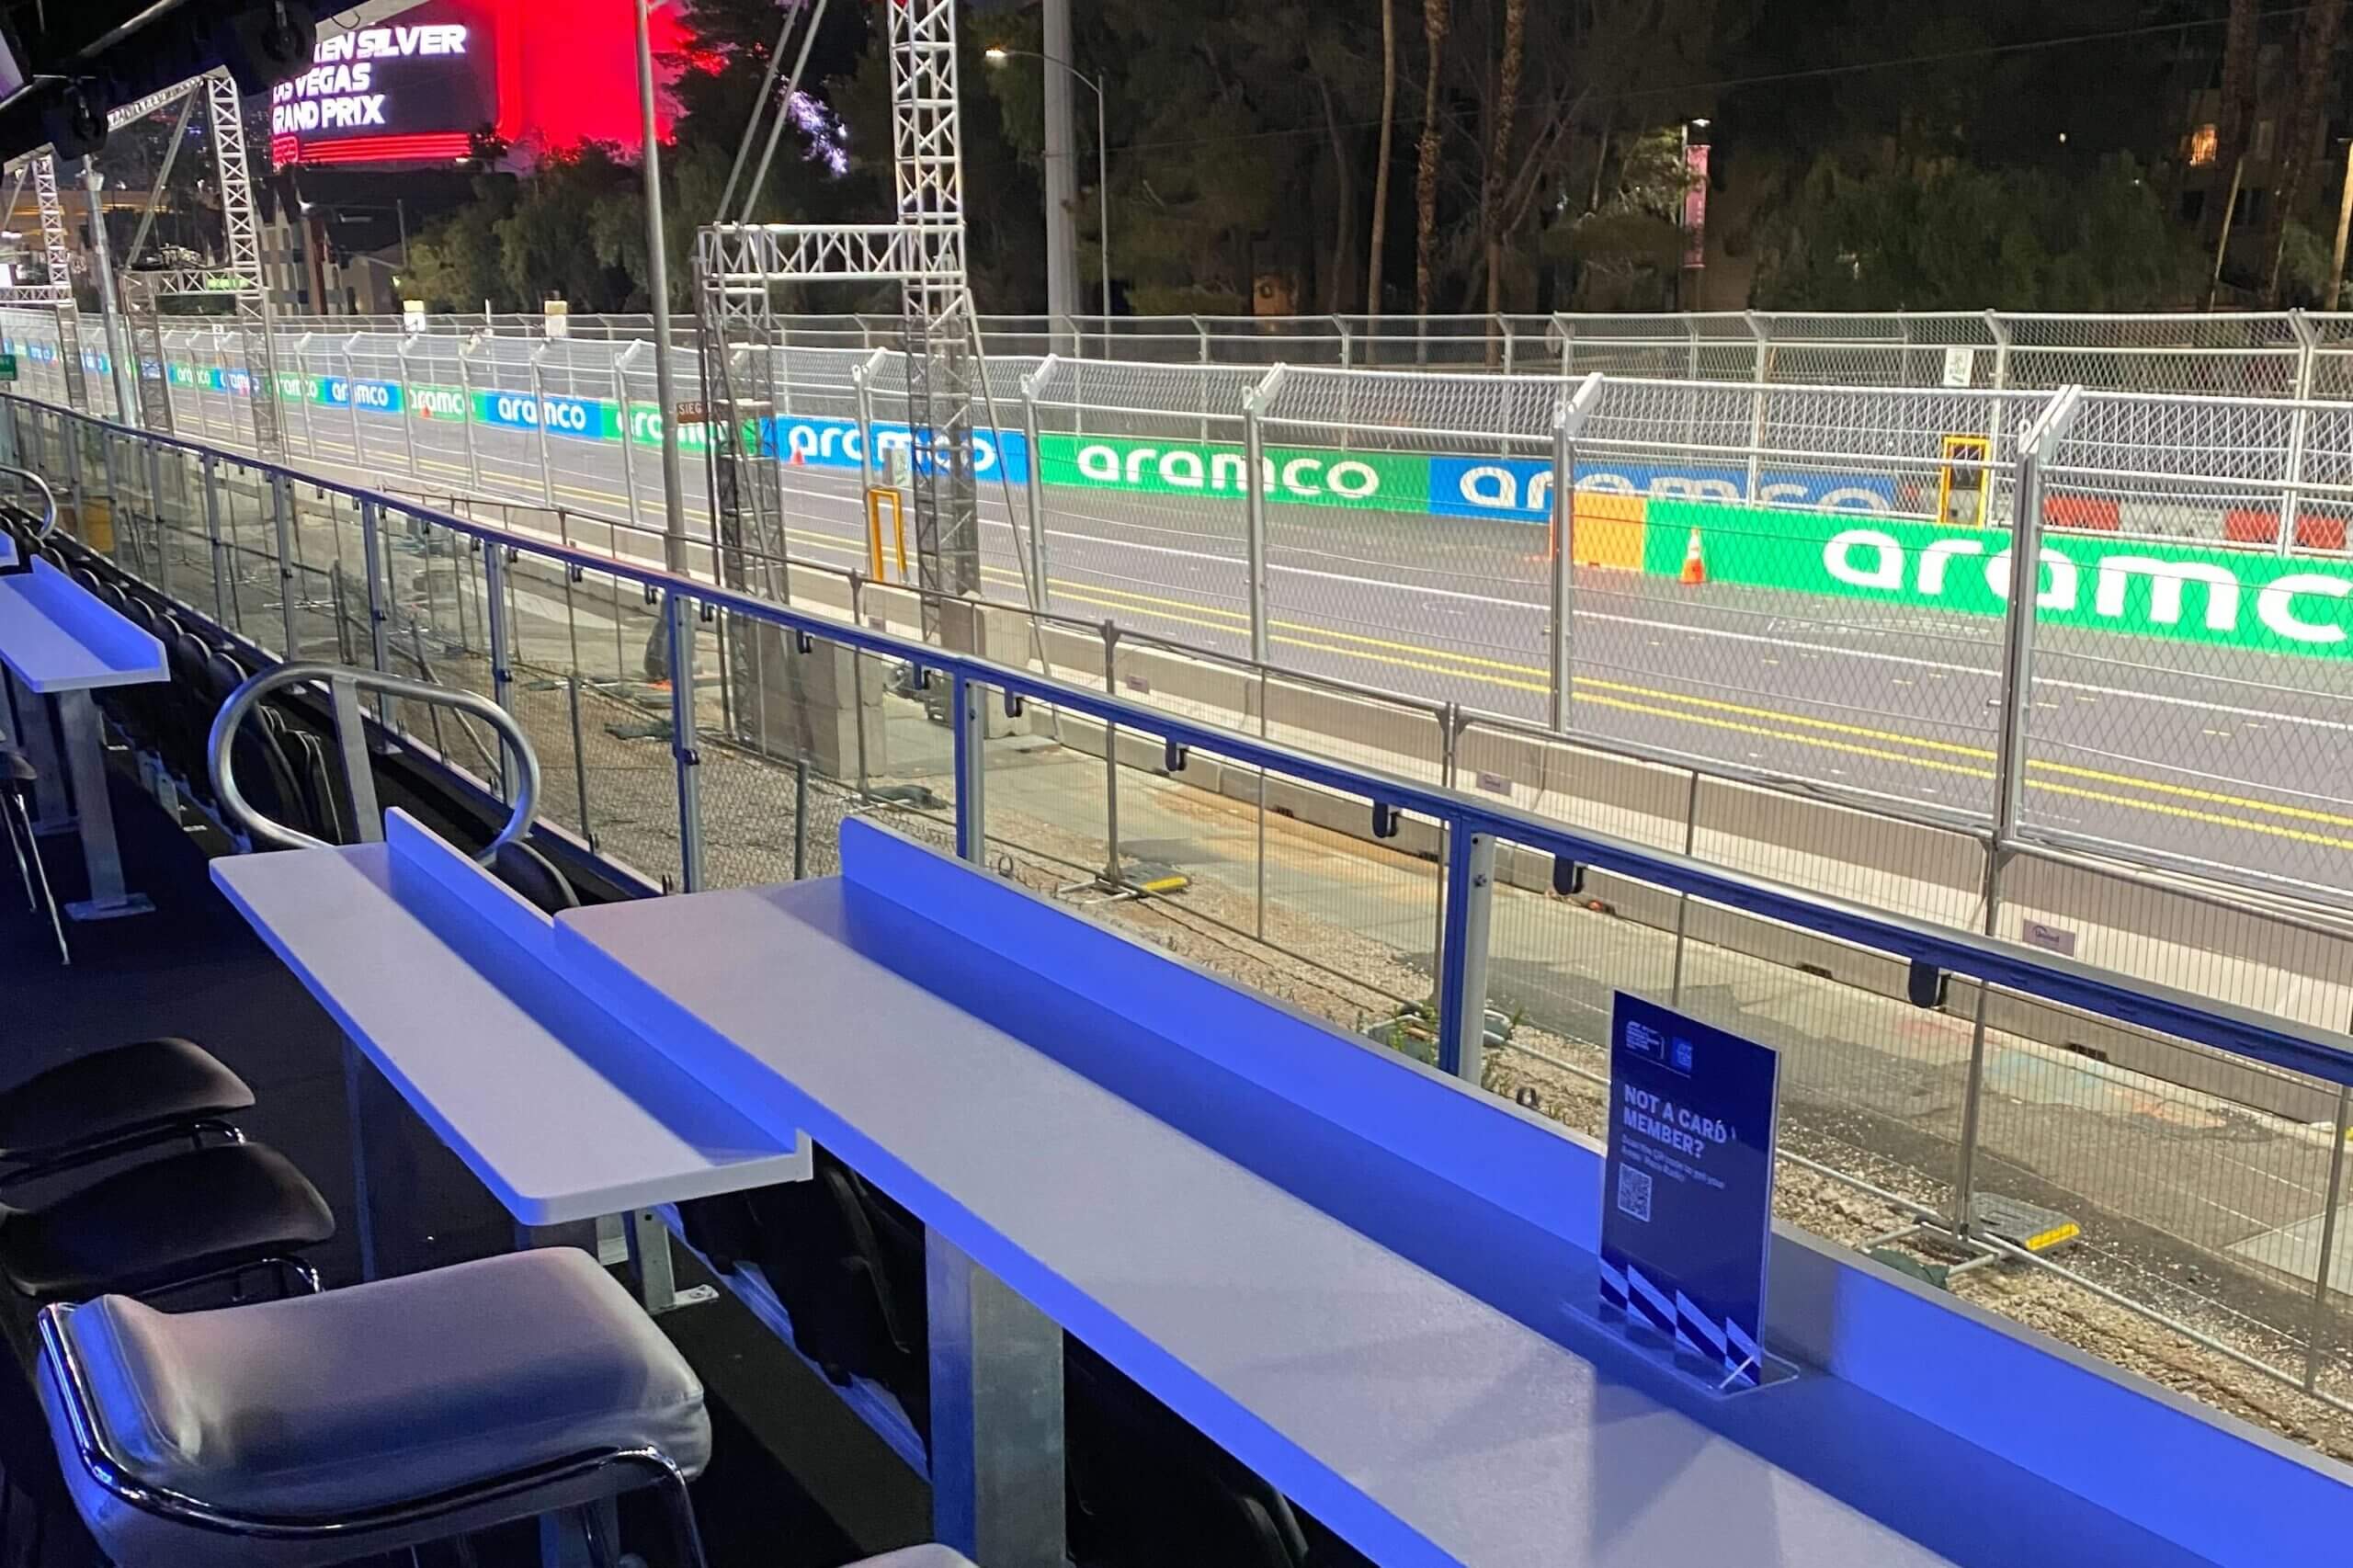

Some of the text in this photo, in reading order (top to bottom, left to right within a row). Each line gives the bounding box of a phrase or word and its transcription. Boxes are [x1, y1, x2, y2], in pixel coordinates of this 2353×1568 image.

[357, 25, 467, 60] SILVER
[295, 62, 371, 97] VEGAS
[322, 94, 385, 128] PRIX
[1077, 445, 1379, 499] aramco
[1623, 1106, 1705, 1158] MEMBER?
[1624, 1084, 1728, 1143] NOT A CARD
